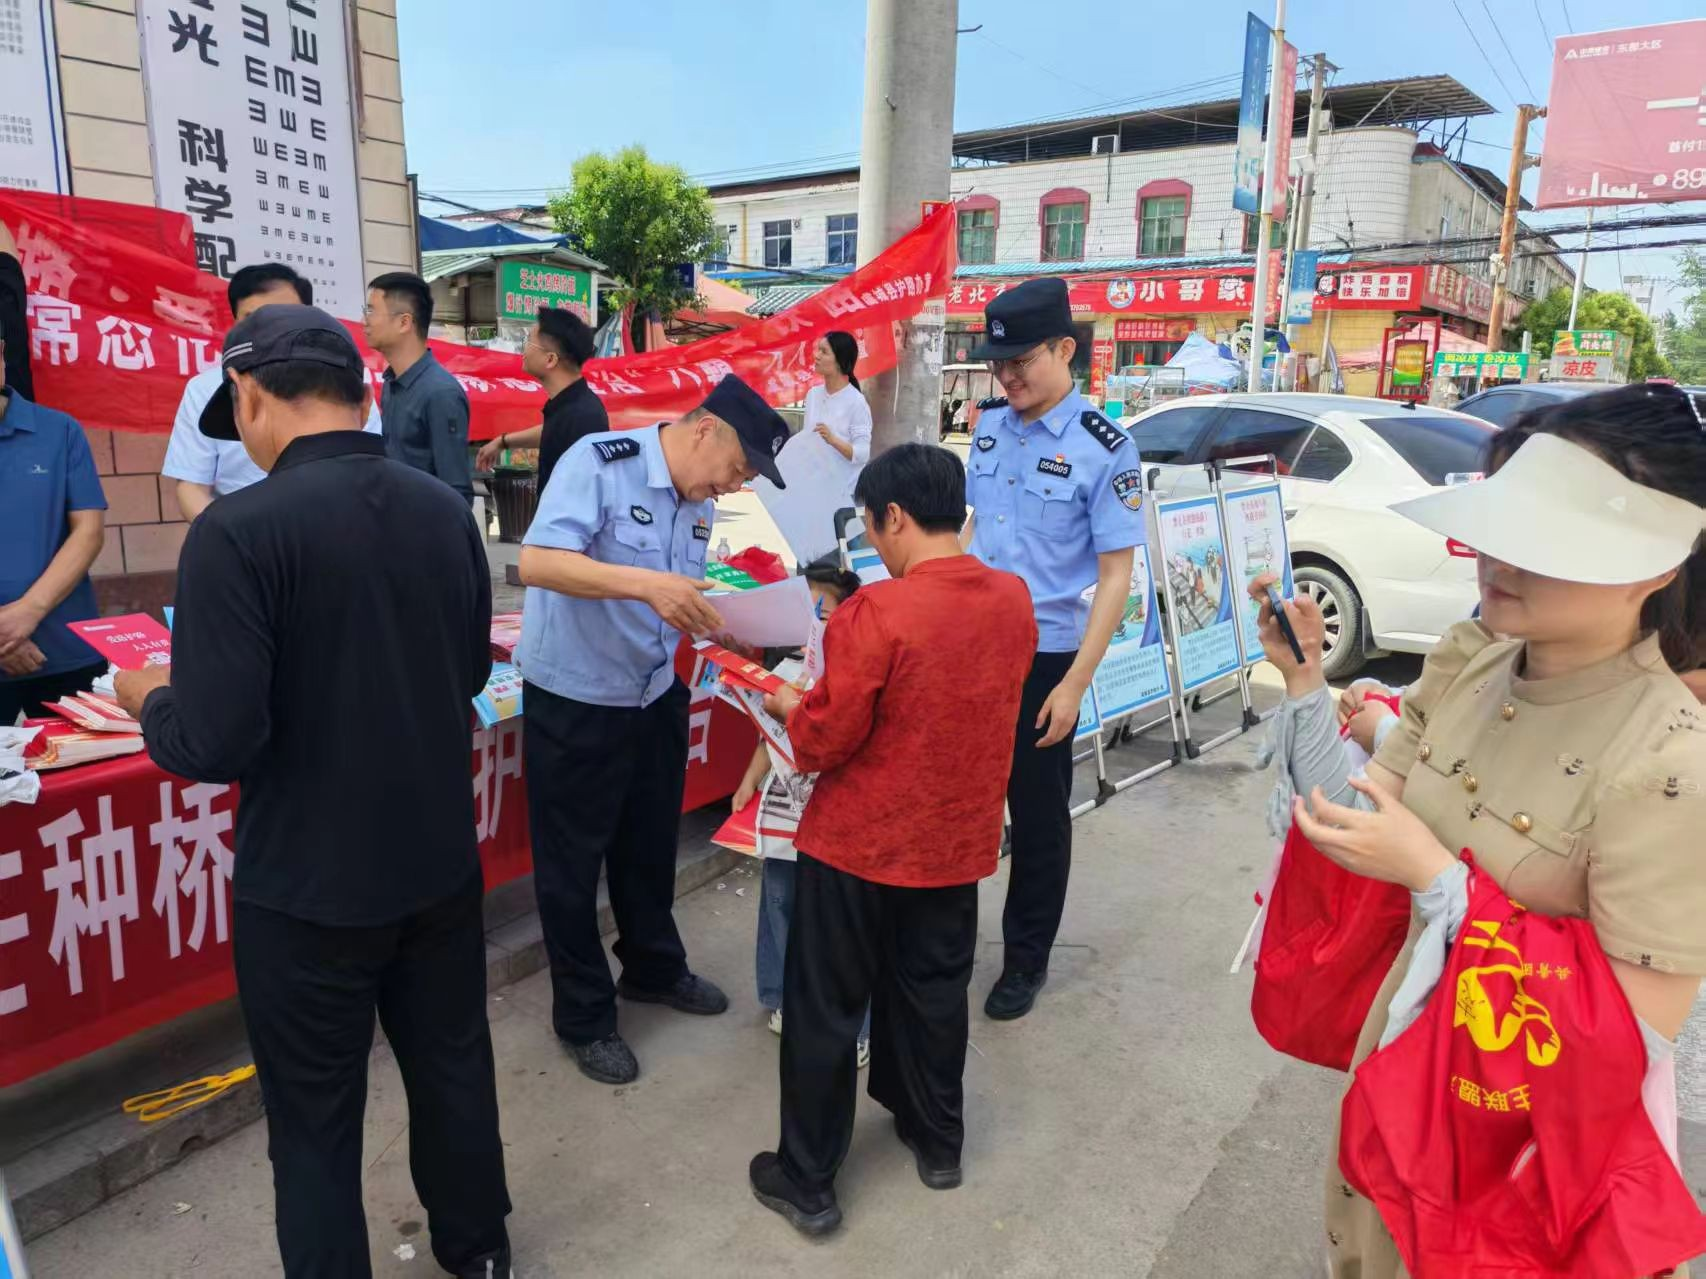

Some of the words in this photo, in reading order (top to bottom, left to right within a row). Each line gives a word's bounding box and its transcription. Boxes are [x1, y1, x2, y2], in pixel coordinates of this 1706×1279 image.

[167, 0, 219, 67] 光
[1342, 287, 1407, 297] 快乐加倍
[1562, 360, 1597, 377] 凉皮
